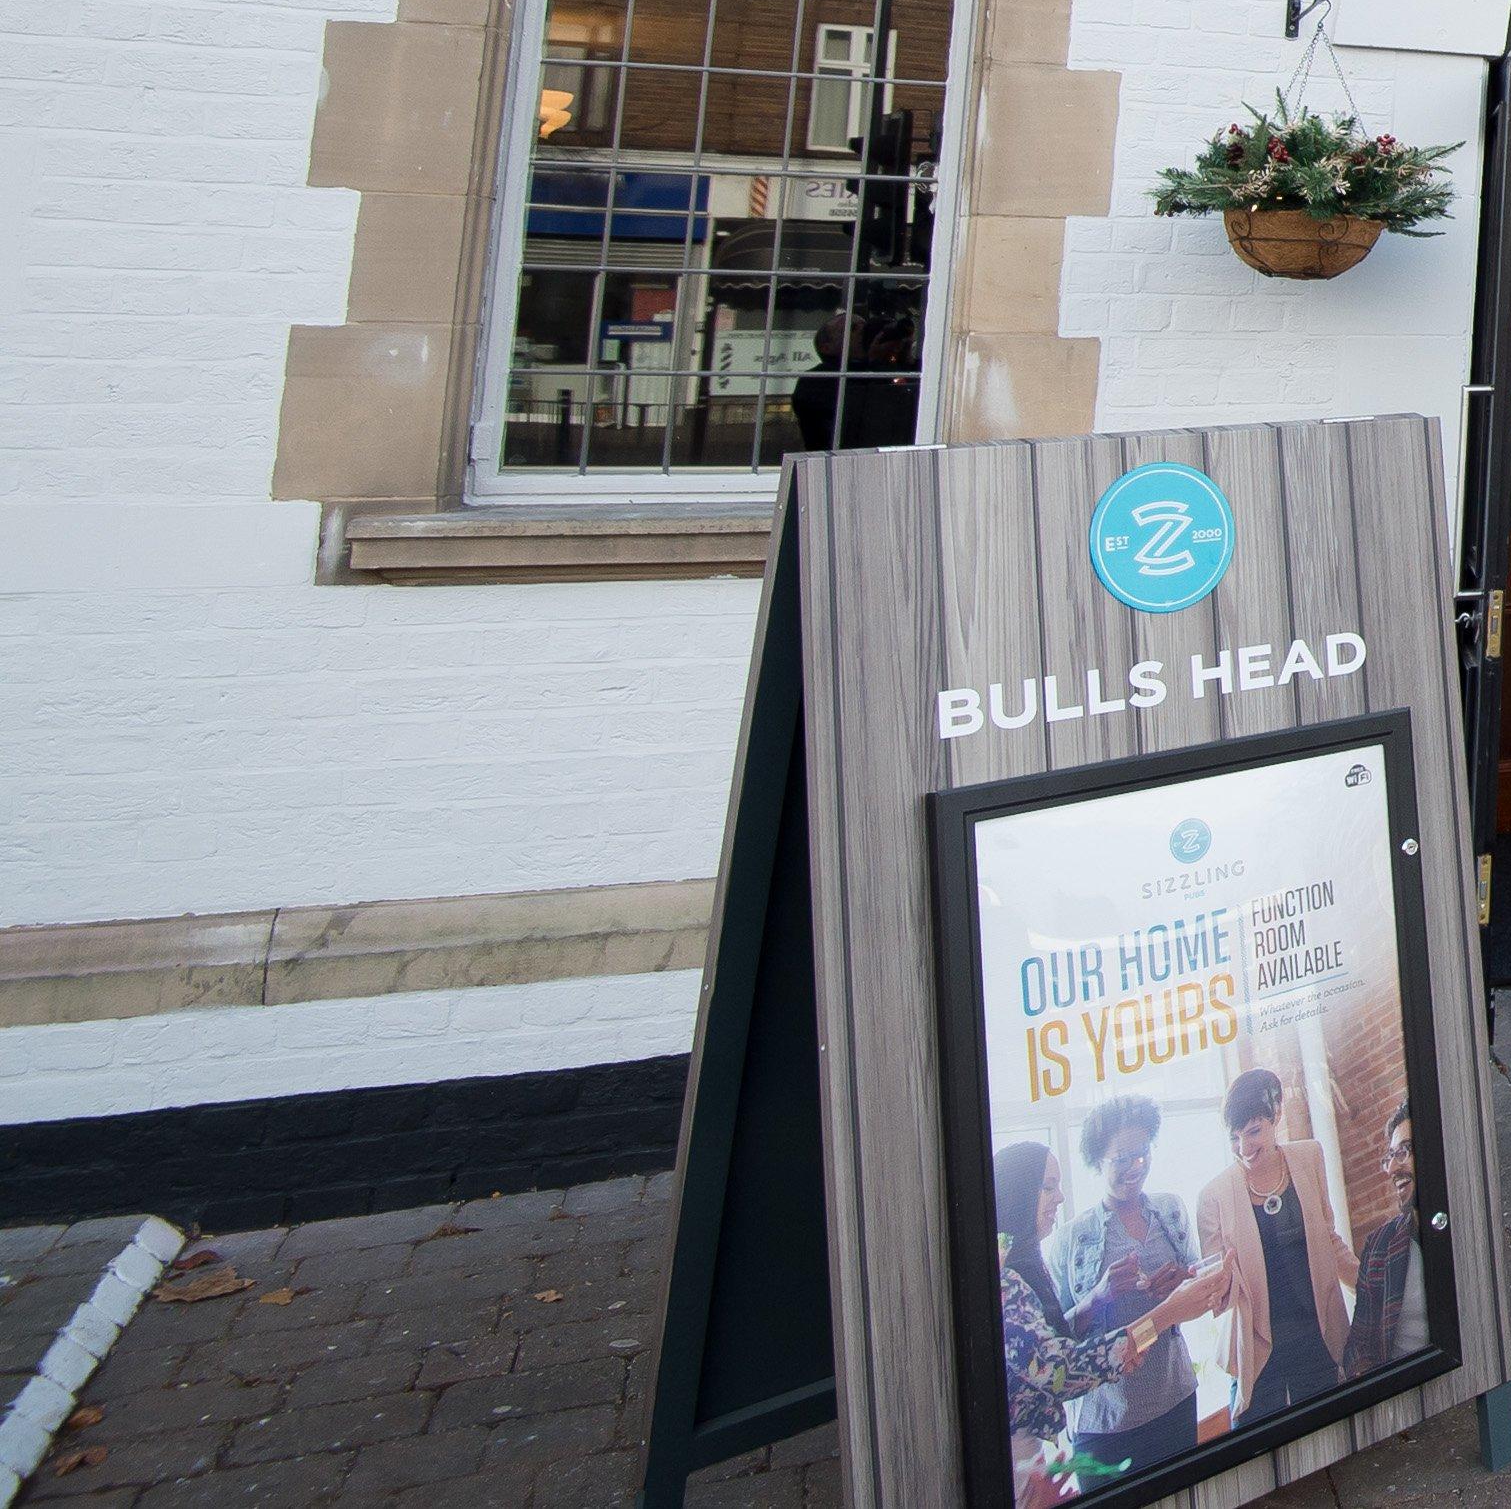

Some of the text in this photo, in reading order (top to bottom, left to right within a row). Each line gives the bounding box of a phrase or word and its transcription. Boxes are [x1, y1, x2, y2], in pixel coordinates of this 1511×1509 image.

[1192, 527, 1223, 541] 2000
[937, 630, 1368, 741] BULLS HEAD
[1141, 859, 1245, 900] SIZZLING
[1251, 879, 1335, 927] FUNCTION
[1253, 919, 1306, 959] ROOM
[1020, 907, 1232, 1017] OUR HOME
[1257, 940, 1344, 991] AVAILABLE
[1259, 995, 1306, 1018] Whatever
[1307, 989, 1322, 1004] the
[1259, 1019, 1282, 1034] Ask
[1280, 1013, 1294, 1029] for
[1025, 970, 1239, 1104] IS YOURS
